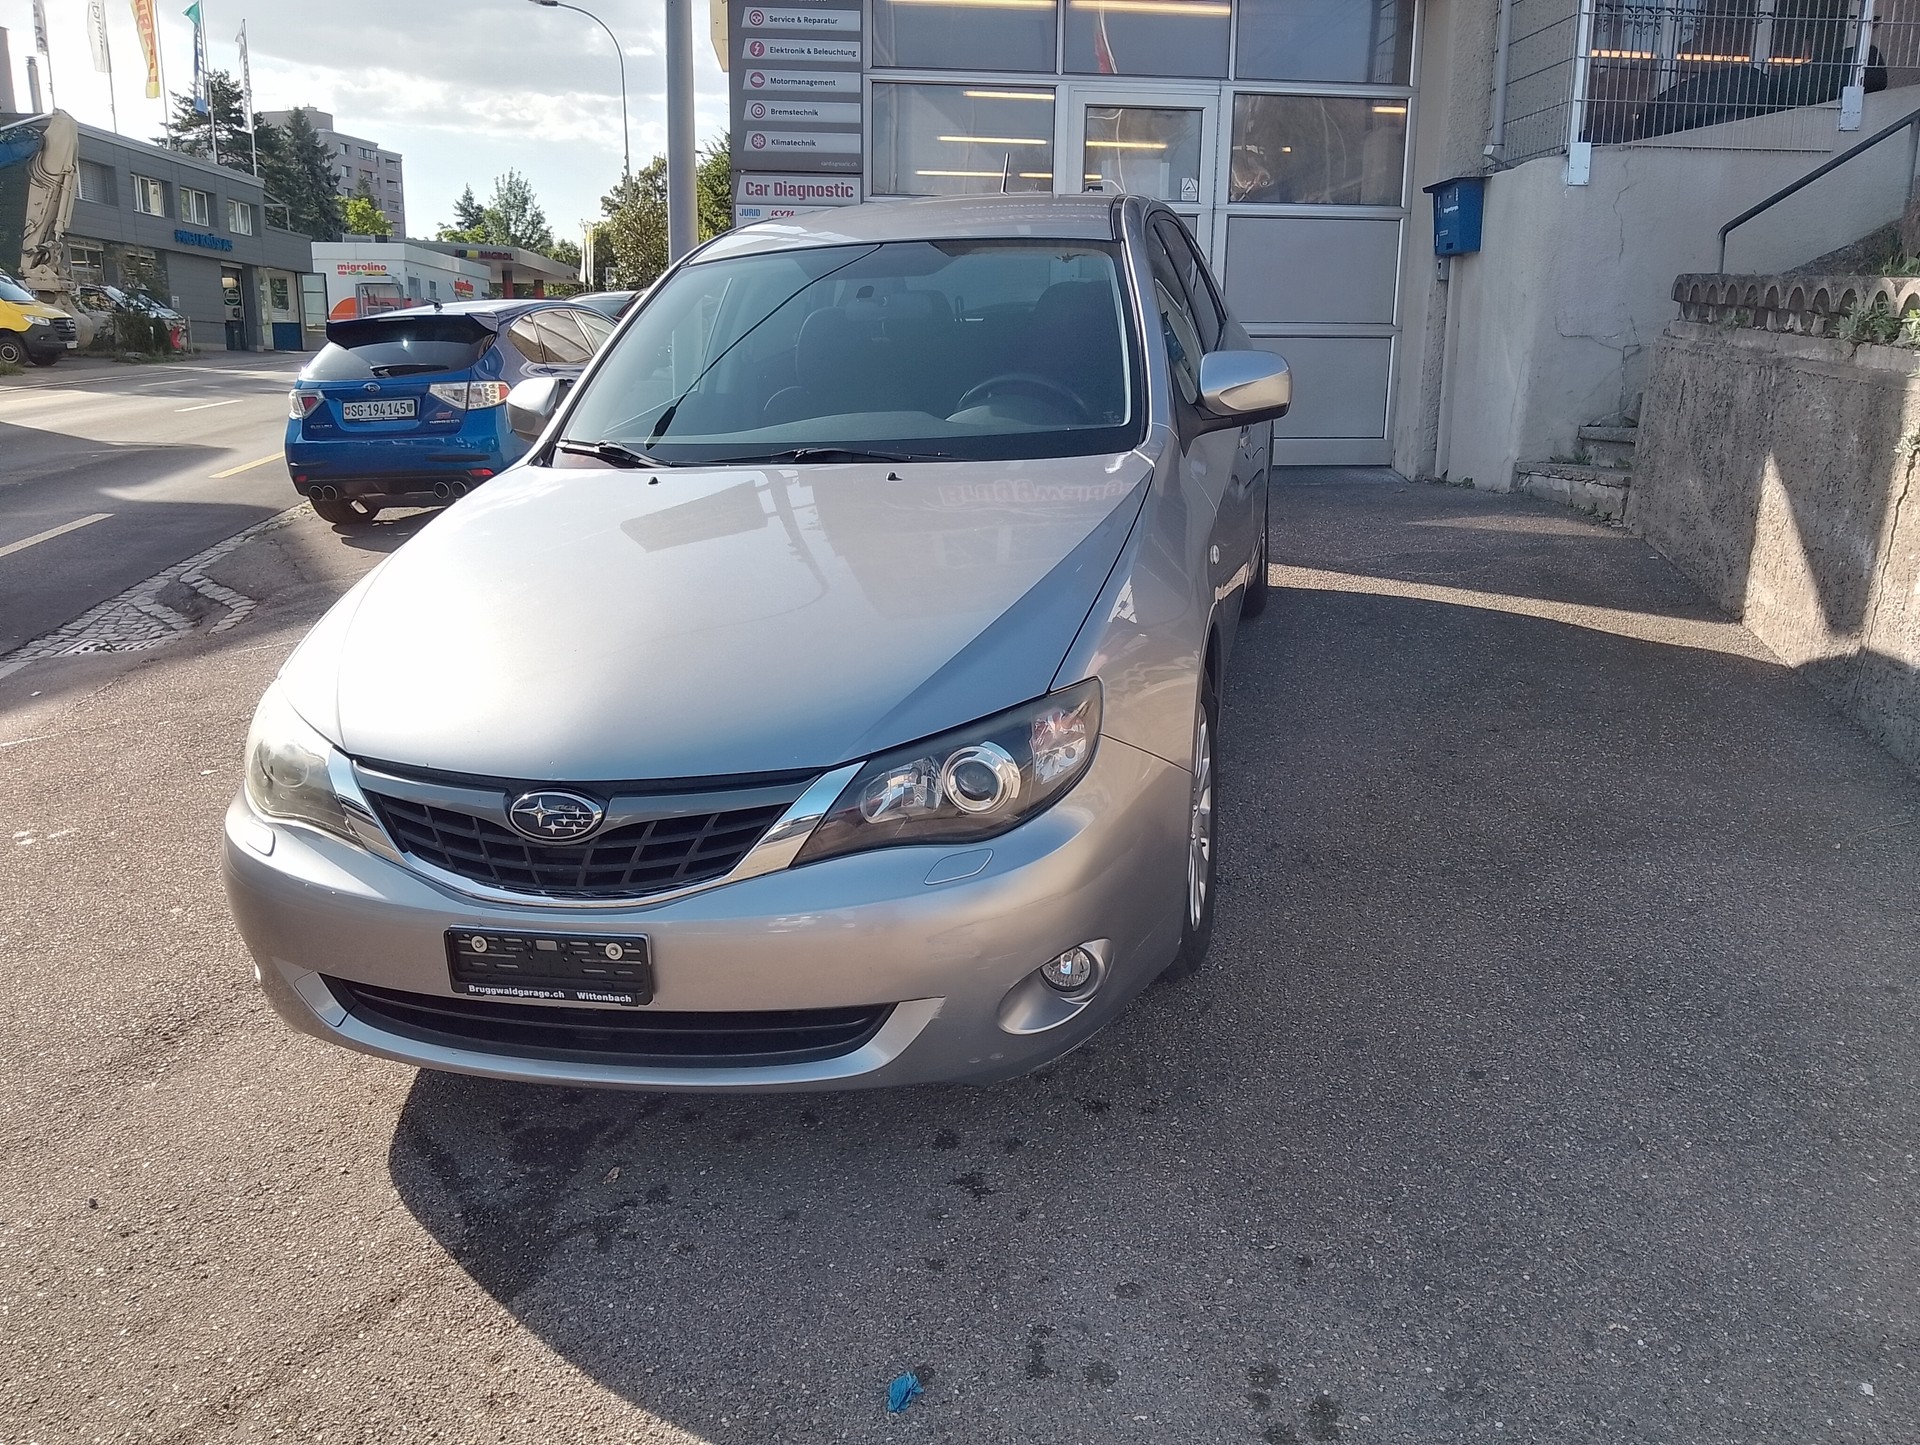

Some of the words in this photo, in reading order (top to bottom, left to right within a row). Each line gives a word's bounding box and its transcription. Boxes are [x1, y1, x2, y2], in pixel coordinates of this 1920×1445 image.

[769, 15, 796, 24] Service
[796, 16, 802, 24] &
[803, 17, 838, 25] Reparatur
[769, 46, 806, 55] Elektronik
[813, 48, 857, 58] Beleuchtung
[770, 77, 836, 88] Motormanagement
[770, 108, 819, 117] Bremstechnik
[771, 138, 817, 148] Klimatechnik
[745, 181, 770, 197] Car
[774, 182, 854, 201] Diagnostic
[739, 208, 761, 217] JURID
[337, 262, 387, 273] migrolino
[468, 984, 565, 999] Bruggwaldgarage.ch
[576, 991, 632, 1003] Wittenbach
